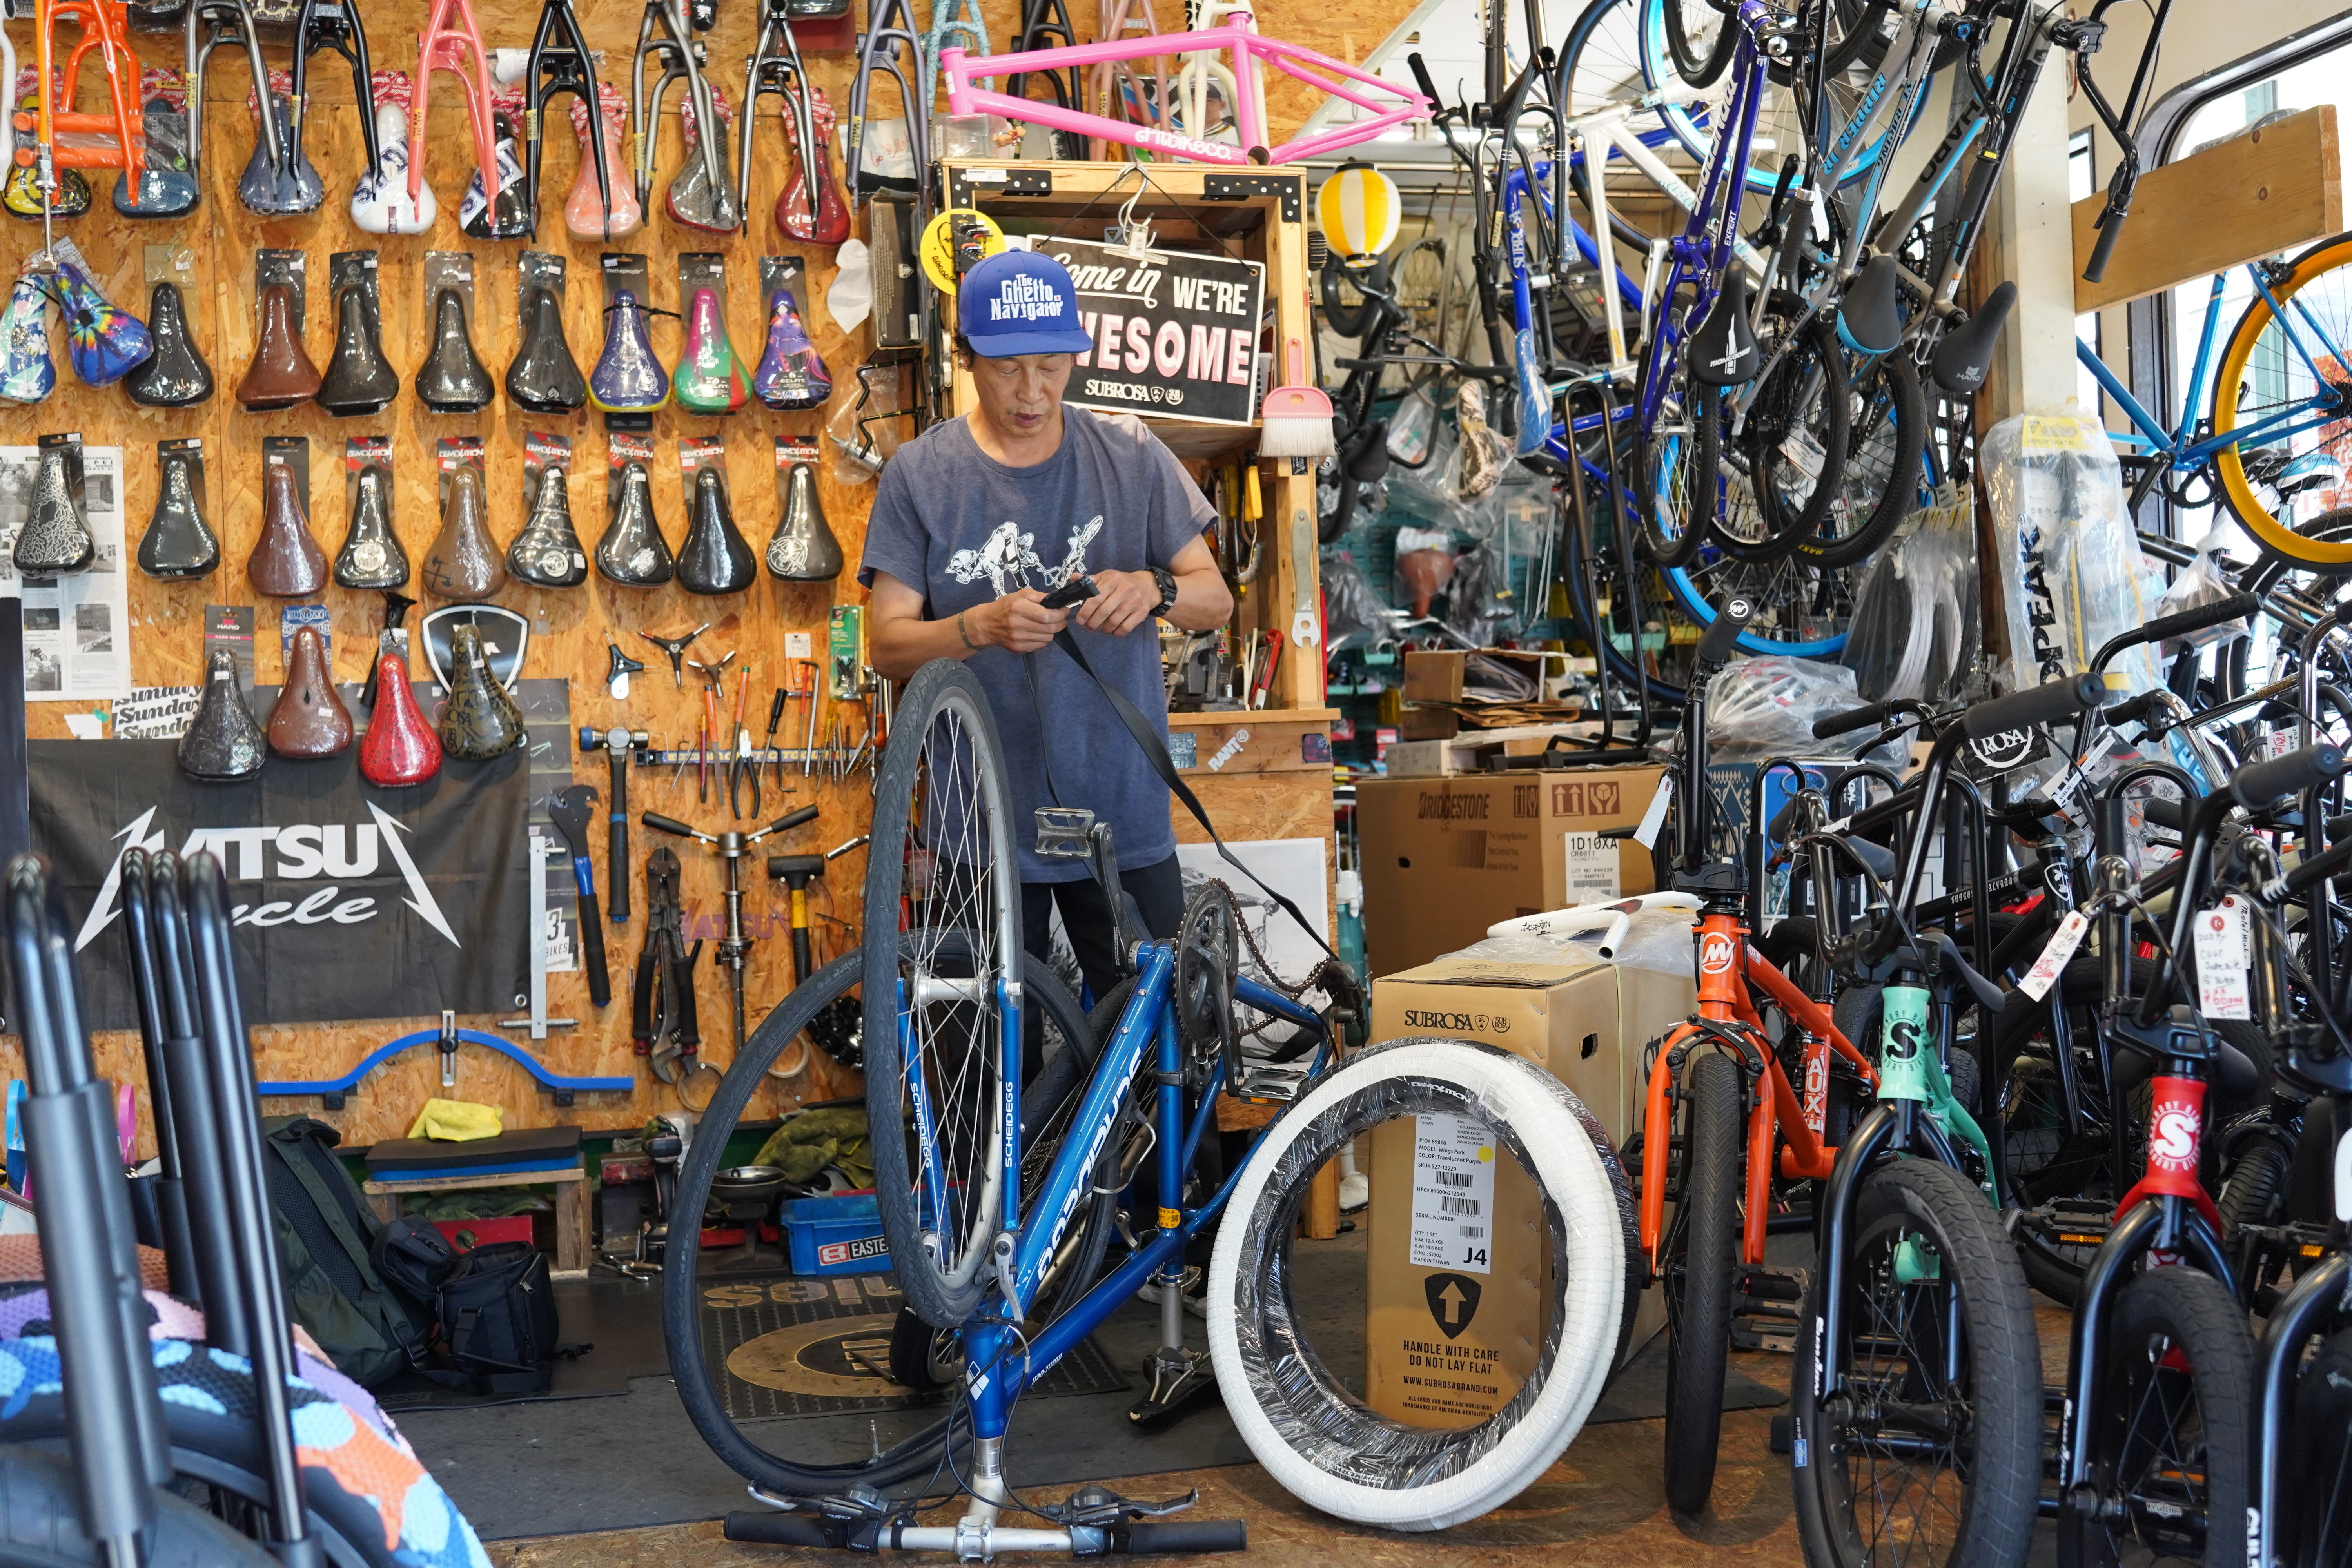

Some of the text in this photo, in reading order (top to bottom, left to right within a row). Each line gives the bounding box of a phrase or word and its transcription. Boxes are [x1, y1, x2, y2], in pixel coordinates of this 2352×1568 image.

[2006, 96, 2016, 114] PRO
[1724, 212, 1736, 247] EXPERT
[1016, 274, 1033, 287] The
[1001, 280, 1055, 303] Ghetto
[1174, 276, 1249, 316] WE'RE
[990, 298, 1063, 321] Navigator
[1074, 310, 1252, 386] WESOME
[1710, 347, 1751, 367] MONGOOSE
[1956, 373, 1980, 382] HARO
[1085, 379, 1151, 403] SUBROSA
[347, 449, 393, 457] DEMOLITION
[439, 448, 484, 458] DEMOLITION
[527, 444, 571, 457] DEMOLITION
[610, 446, 653, 458] DEMOLITION
[680, 447, 724, 461] DEMOLITION
[776, 447, 819, 456] DEMOLITION
[1981, 729, 2028, 756] ROSA
[1418, 791, 1490, 820] BRIDGESTONE
[1571, 837, 1618, 850] 1D10XA
[1404, 1009, 1475, 1031] SUBROSA
[1724, 1027, 1744, 1043] TEKTRO
[1885, 1022, 1921, 1059] S
[1411, 1082, 1472, 1104] DEMOLITION
[910, 1082, 932, 1169] SCHEIDEGG
[2154, 1113, 2196, 1157] S
[1437, 1154, 1465, 1163] Translucent
[1430, 1189, 1466, 1197] 810006212549
[1463, 1247, 1487, 1266] J4
[1403, 1340, 1499, 1361] HANDLE WITH CARE
[1409, 1354, 1493, 1375] DO NOT LAY FLAT
[1403, 1376, 1498, 1395] WWW.SUBROSABRAND.COM
[1402, 1402, 1431, 1410] TRADEMARKS
[1438, 1406, 1461, 1414] AMERICAN
[1462, 1409, 1488, 1418] MENTALITY,
